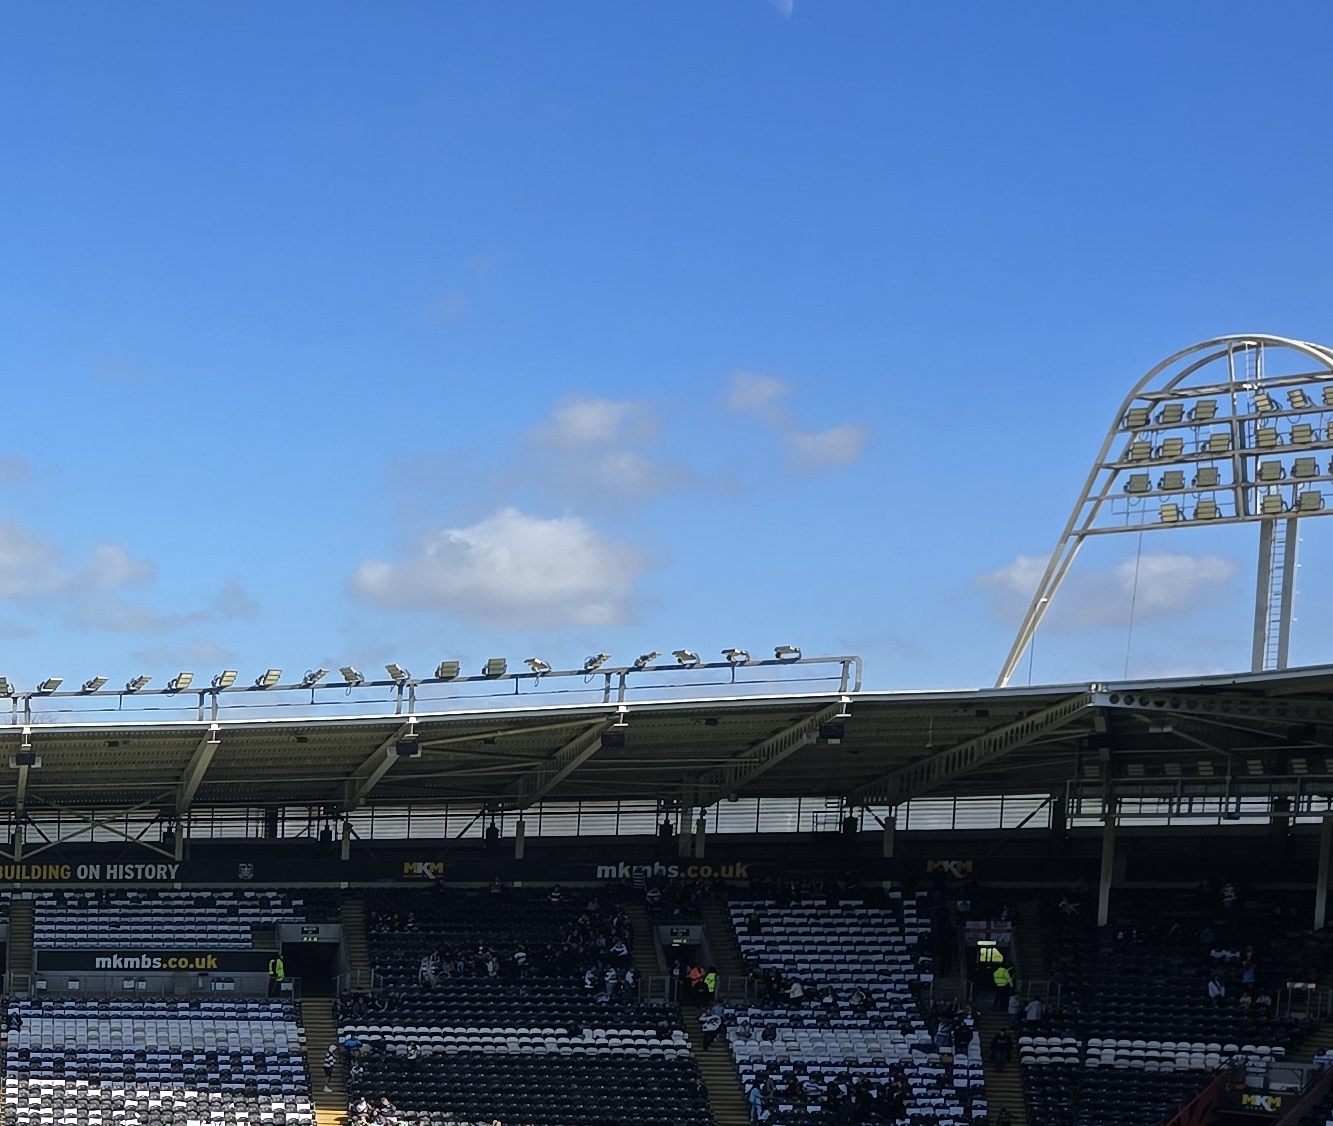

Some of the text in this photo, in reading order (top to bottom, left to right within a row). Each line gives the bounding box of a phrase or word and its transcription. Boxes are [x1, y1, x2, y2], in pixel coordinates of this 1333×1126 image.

[77, 865, 100, 880] ON
[106, 864, 179, 880] HISTORY
[403, 862, 443, 879] MKM
[95, 954, 217, 969] mkmbs.co.uk
[1242, 1094, 1281, 1112] MKM
